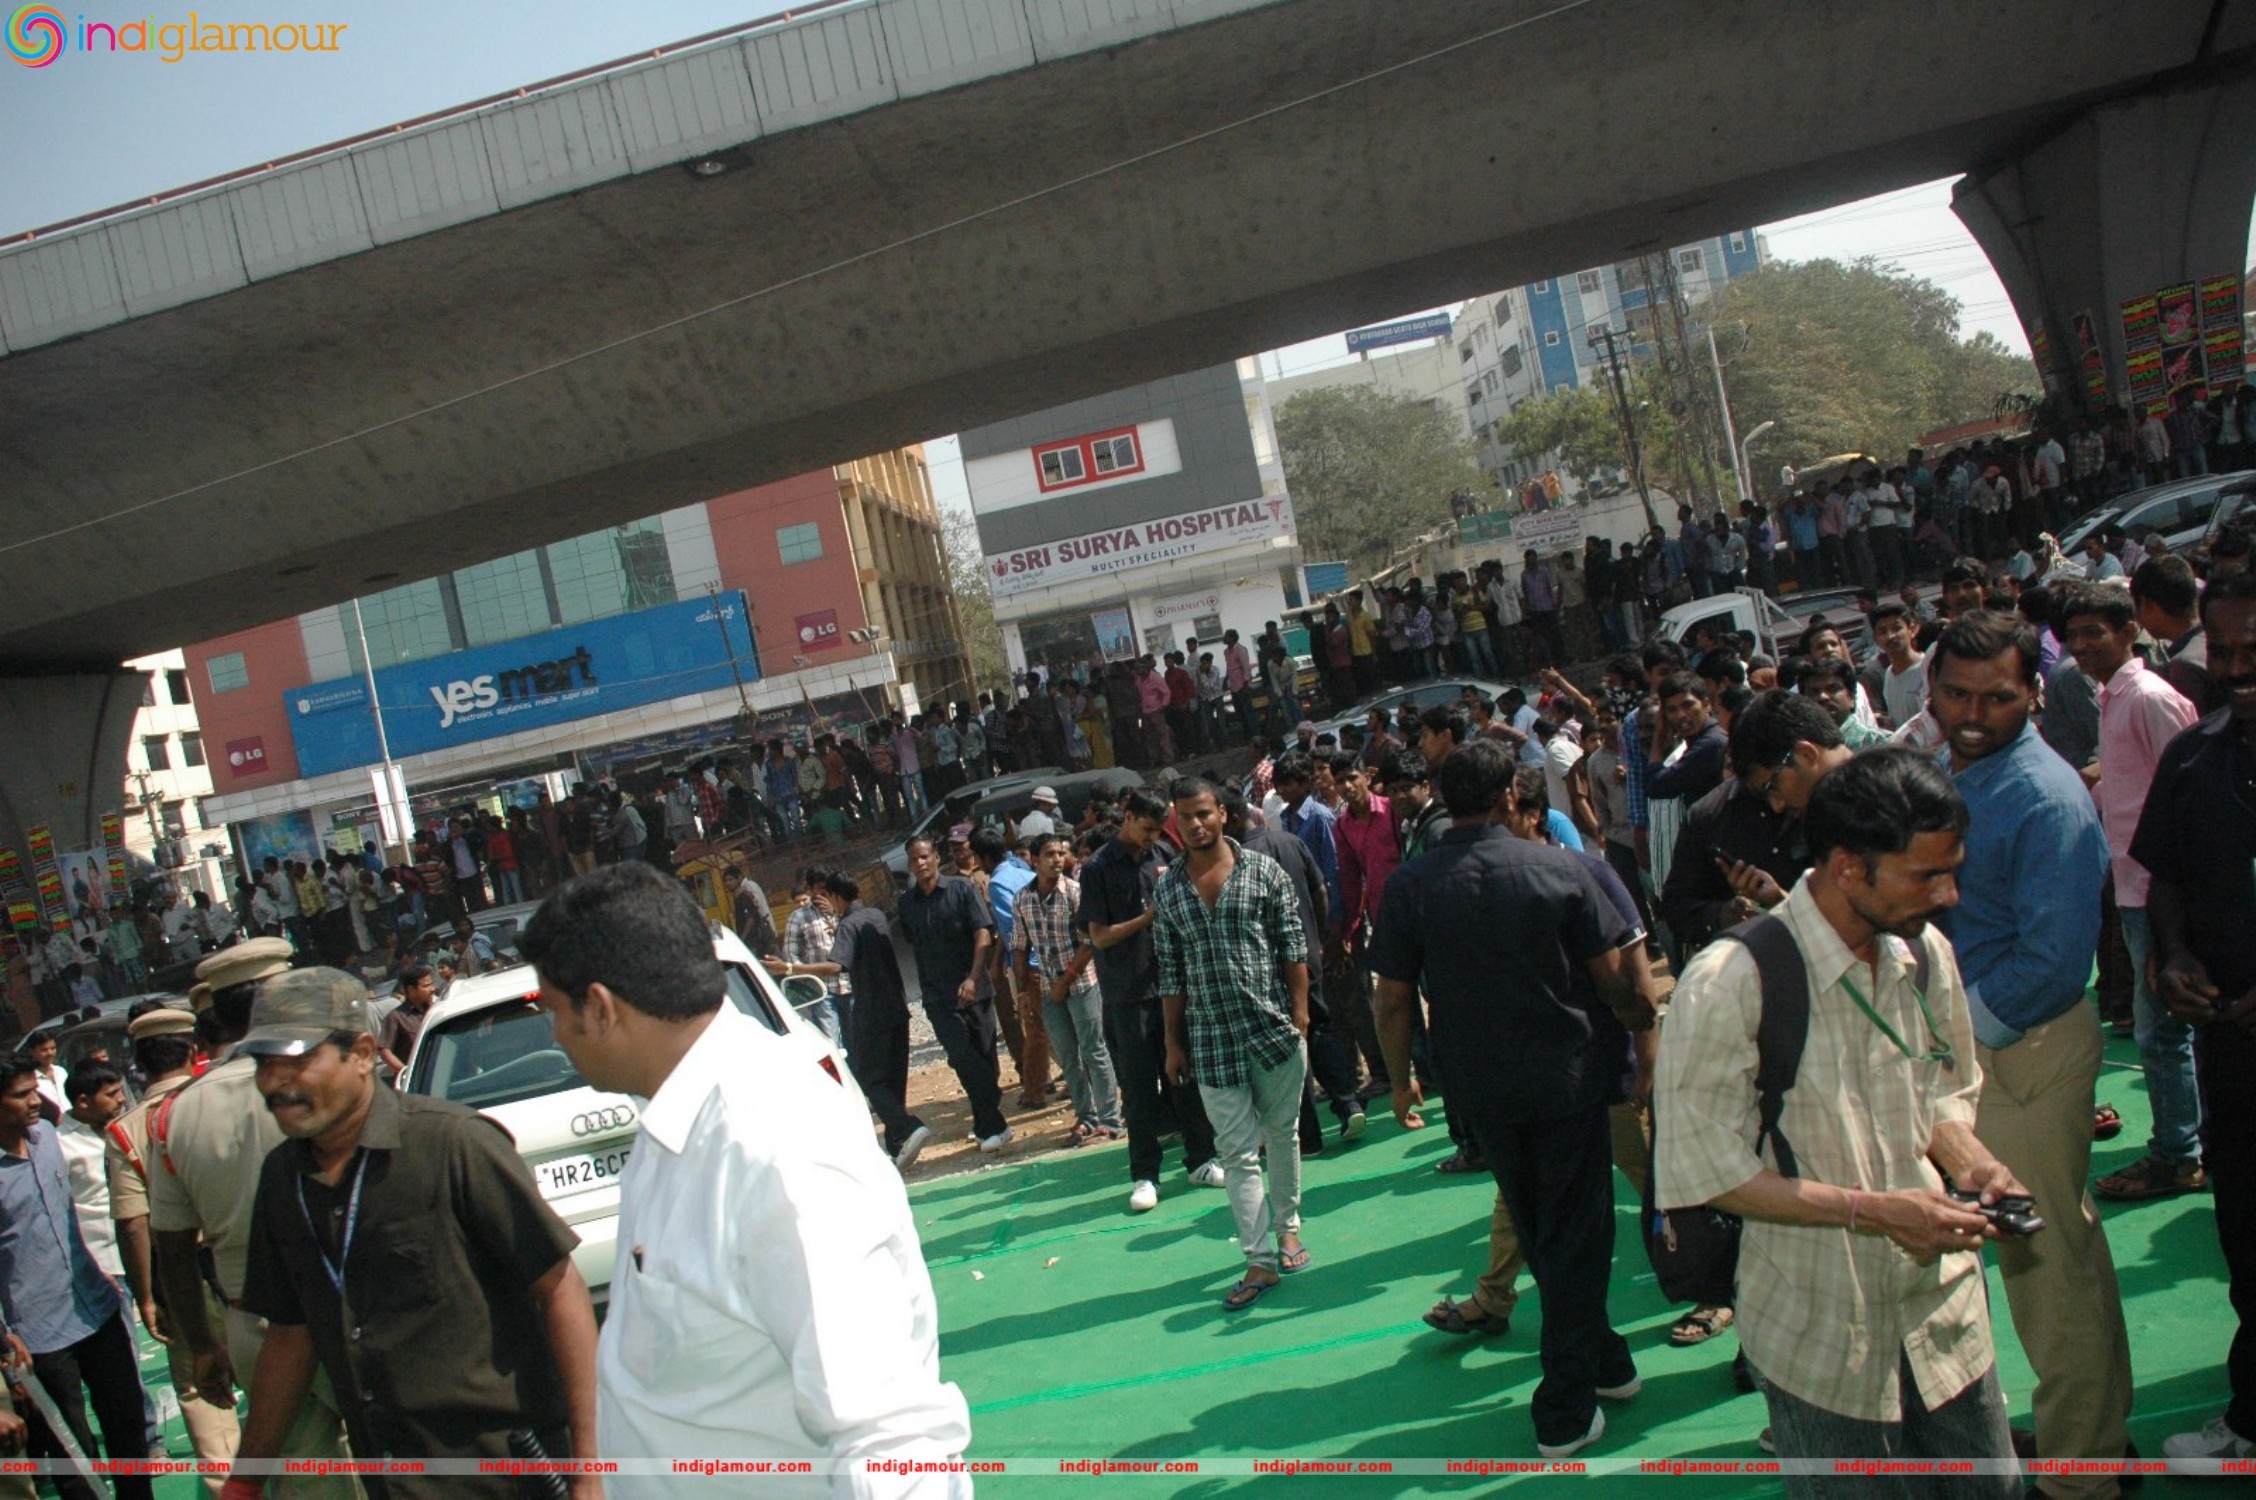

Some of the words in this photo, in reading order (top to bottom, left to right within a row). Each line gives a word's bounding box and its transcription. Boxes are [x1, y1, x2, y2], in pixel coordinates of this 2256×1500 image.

[1011, 546, 1051, 574] SRI
[1058, 526, 1141, 562] SURYA
[1146, 502, 1269, 542] HOSPITAL
[1091, 557, 1126, 574] MULTI
[1128, 543, 1196, 566] SPECIALITY
[818, 623, 837, 636] LG
[430, 675, 498, 728] yes
[498, 645, 597, 703] mart
[457, 711, 493, 723] electronics
[760, 709, 793, 722] SONY
[246, 748, 263, 760] LG
